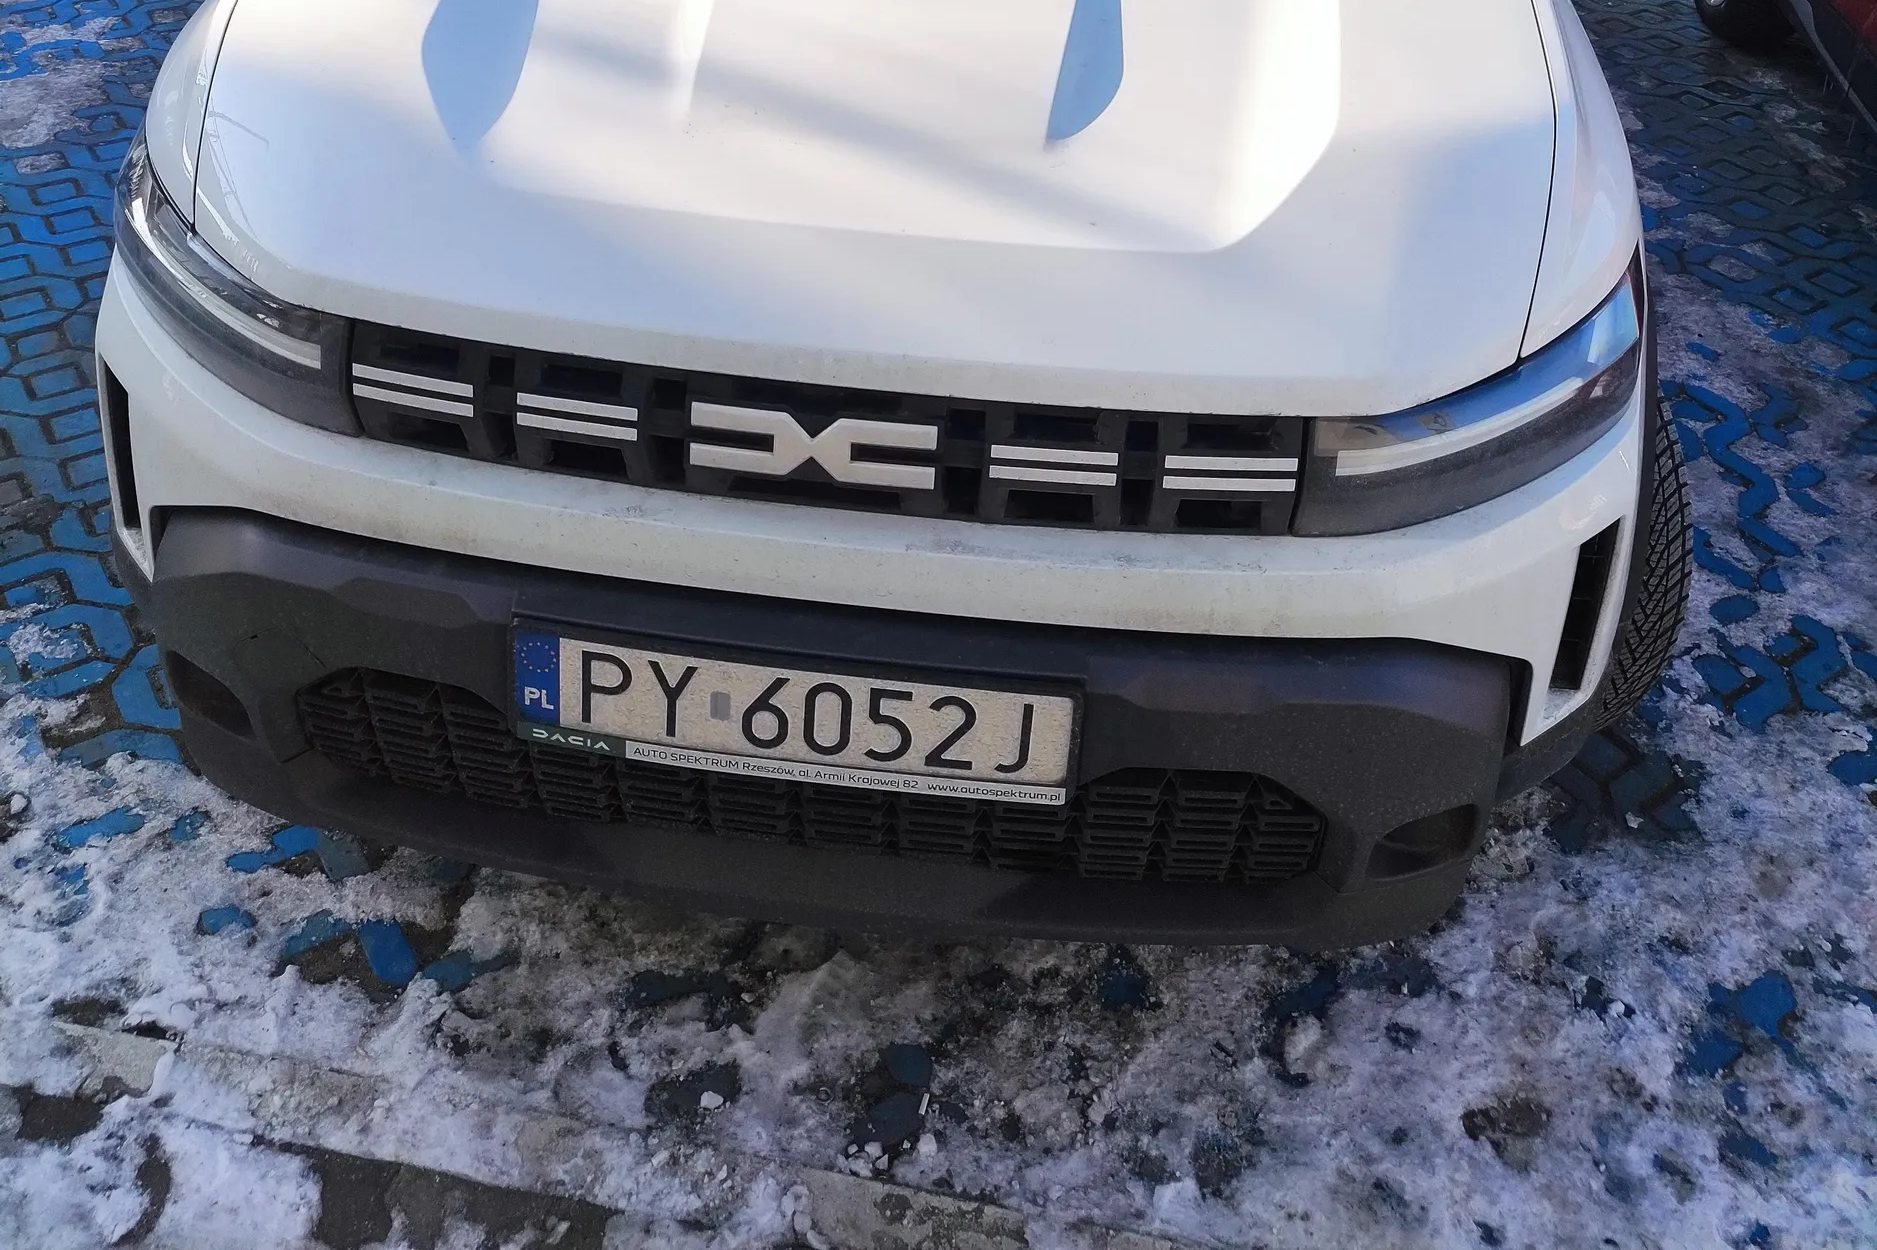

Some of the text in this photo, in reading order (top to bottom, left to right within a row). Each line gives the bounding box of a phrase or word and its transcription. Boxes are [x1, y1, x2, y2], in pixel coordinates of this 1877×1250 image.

[524, 686, 554, 711] PL
[580, 649, 1035, 774] PY 6052J
[532, 728, 610, 751] DACIA
[633, 747, 1062, 802] AUTO SPEKTRUM Rzeszów, al. Armii Krajowej 82 www.autospektrum.pl
